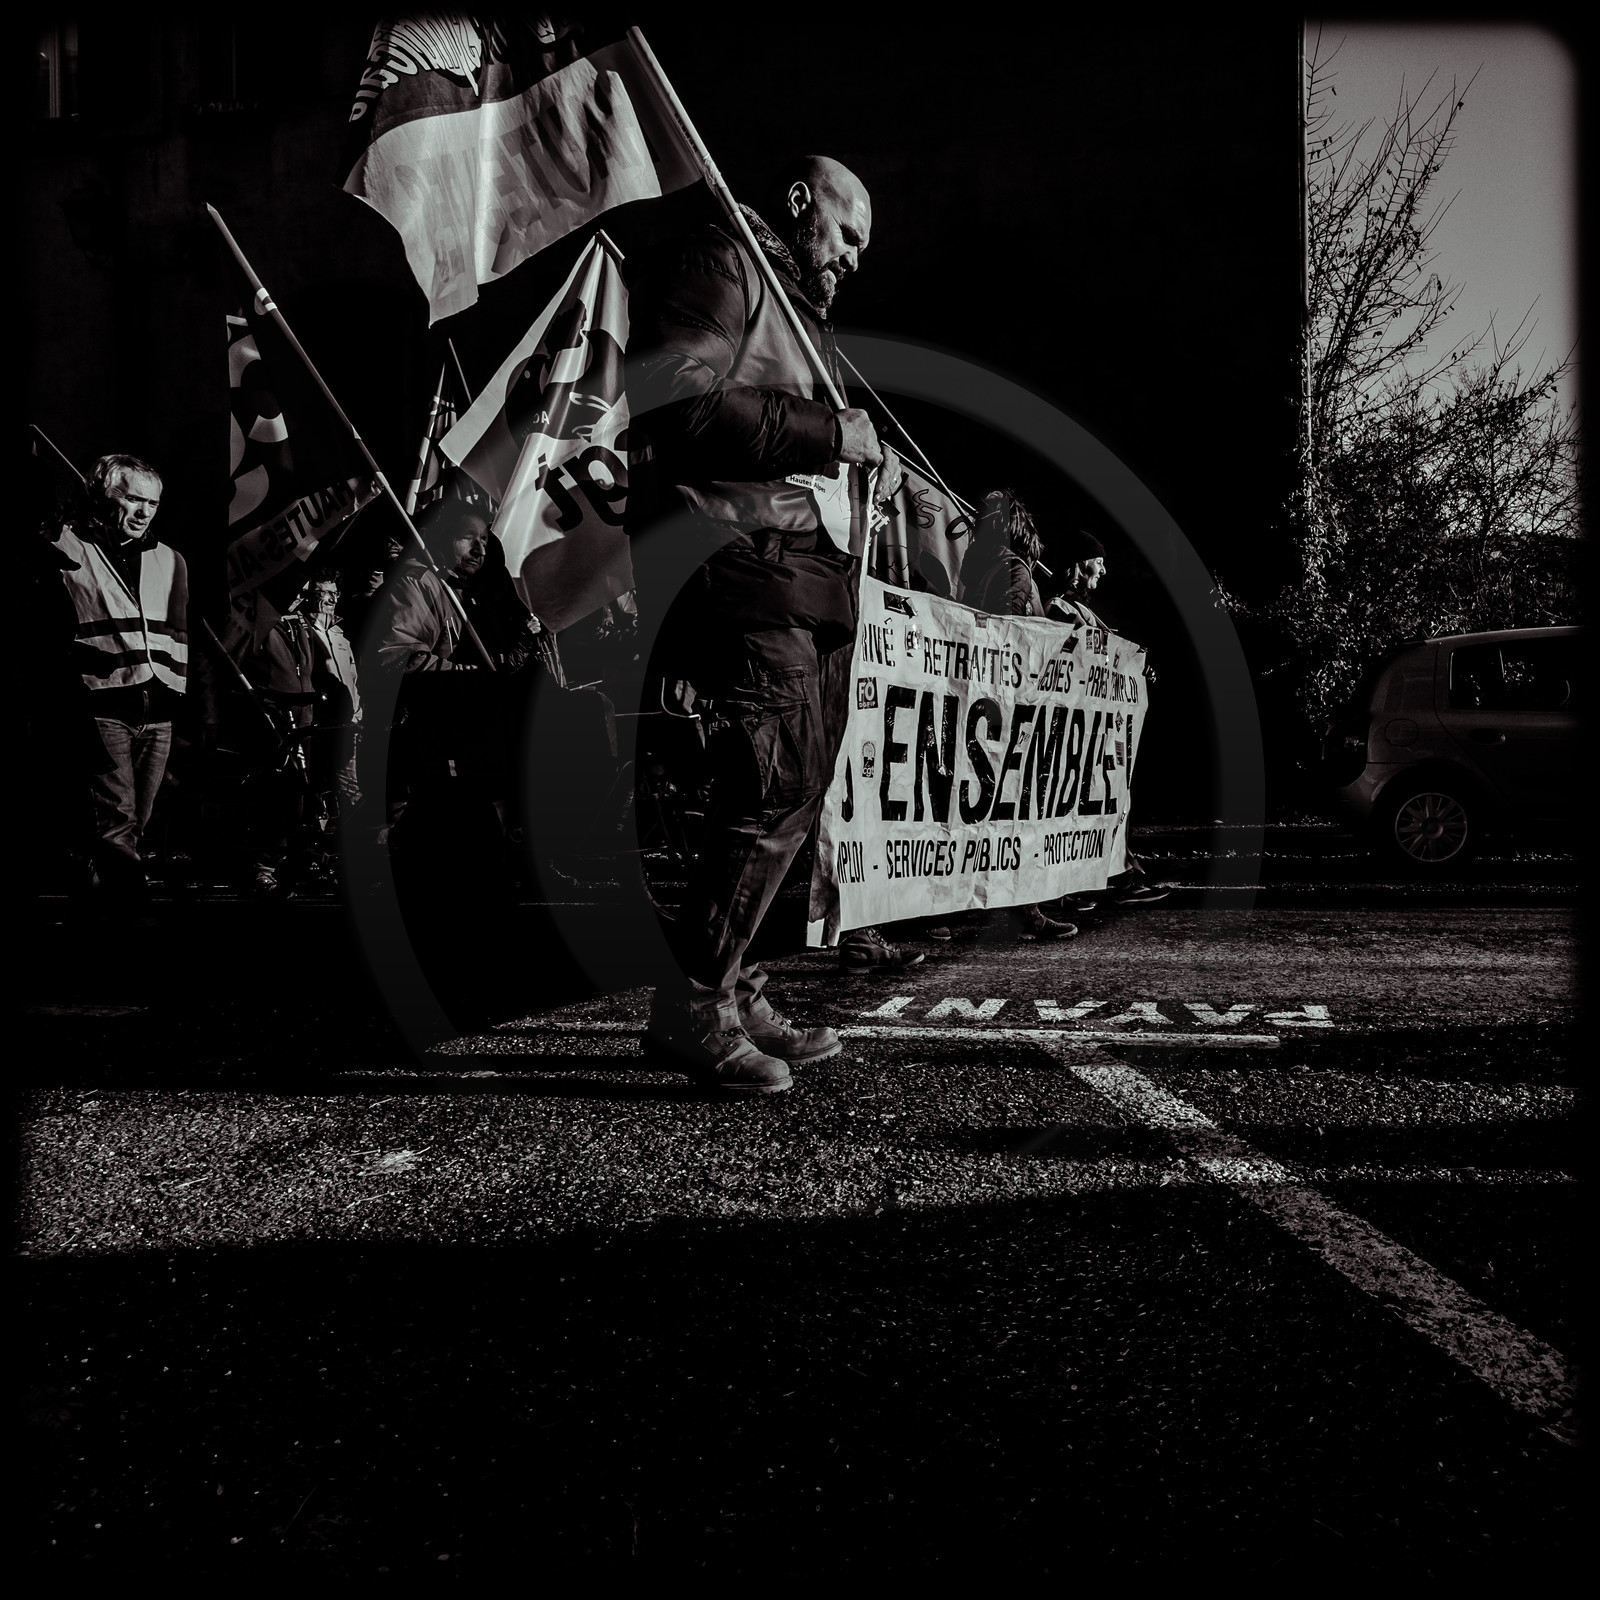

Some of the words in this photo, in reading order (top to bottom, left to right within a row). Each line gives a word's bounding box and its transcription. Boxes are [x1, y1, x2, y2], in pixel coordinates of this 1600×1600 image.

[789, 475, 812, 487] Hautes
[923, 636, 1022, 690] RETRAITÉS
[880, 684, 1119, 825] ENSEMBLE
[886, 839, 957, 880] SERVICES
